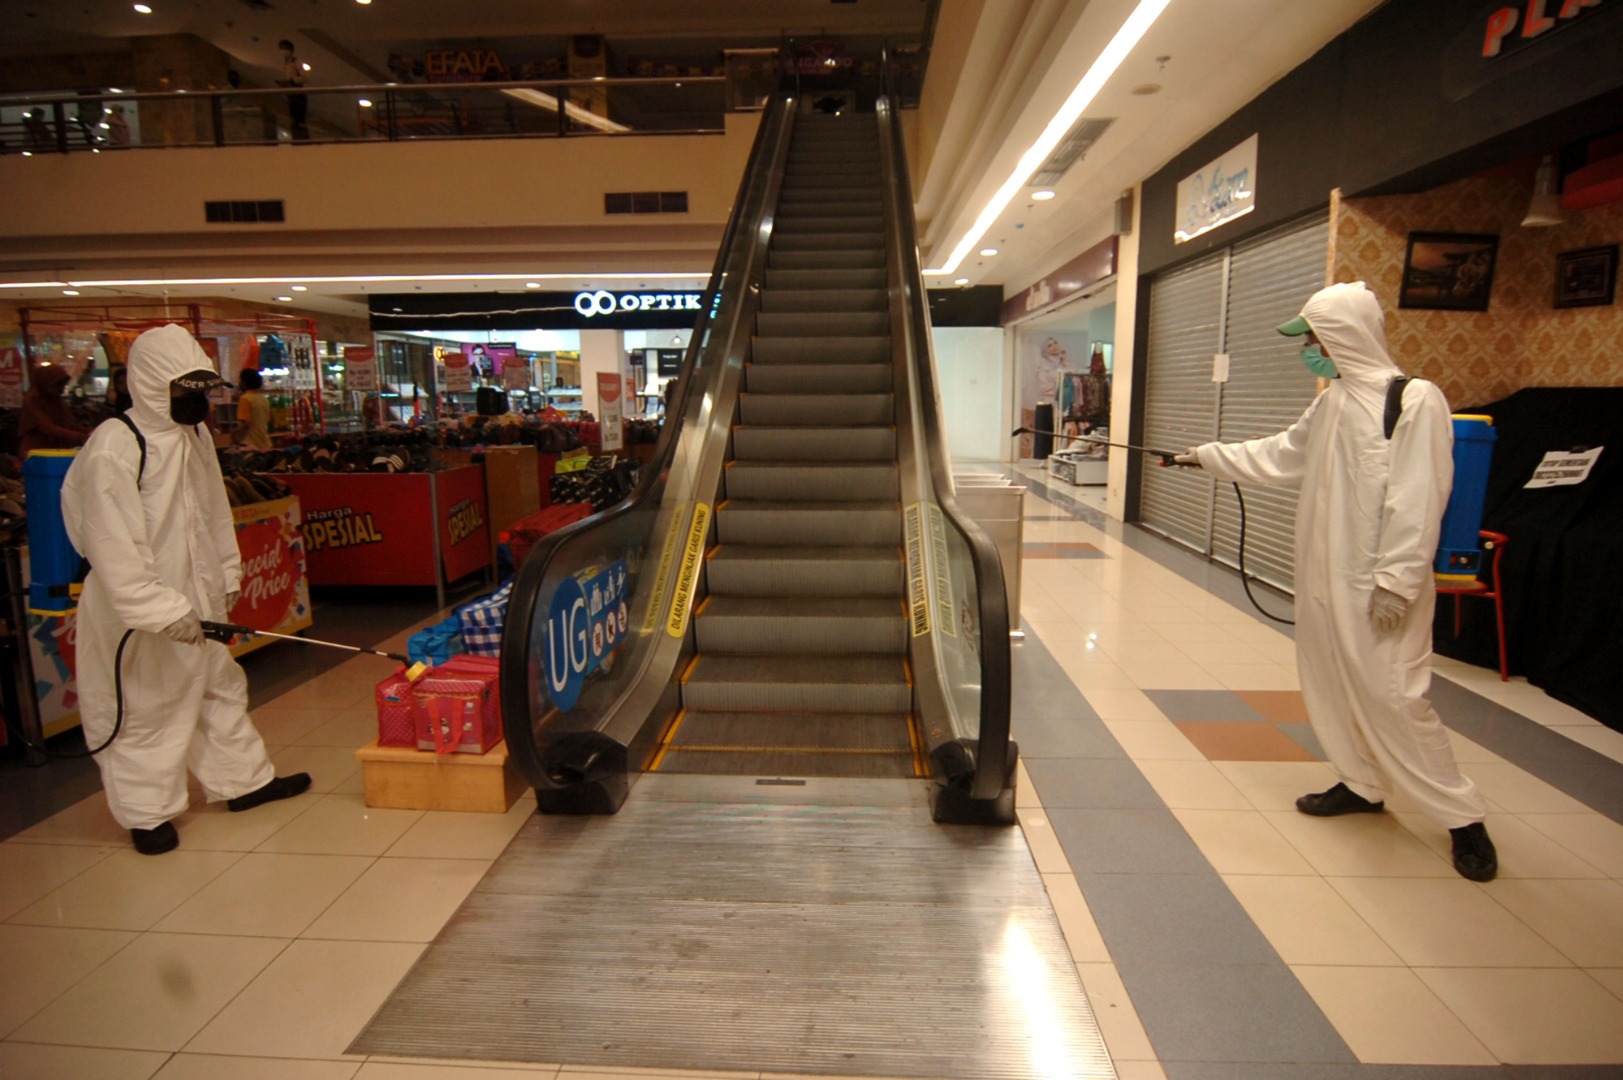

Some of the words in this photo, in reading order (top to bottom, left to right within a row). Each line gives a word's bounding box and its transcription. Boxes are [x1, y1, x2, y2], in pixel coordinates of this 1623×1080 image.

[426, 48, 508, 75] EFATA
[620, 294, 702, 310] OPTIK
[306, 507, 353, 521] Harga
[448, 503, 484, 545] SPESIAL
[694, 509, 706, 534] KUNING
[303, 514, 383, 551] SPESIAL
[689, 533, 703, 553] GARIS
[680, 552, 697, 593] MENGINJAK
[244, 571, 290, 610] Price
[912, 580, 925, 604] GARIS
[670, 593, 688, 630] DILARANG
[914, 604, 928, 635] KUNING
[548, 597, 589, 693] UG
